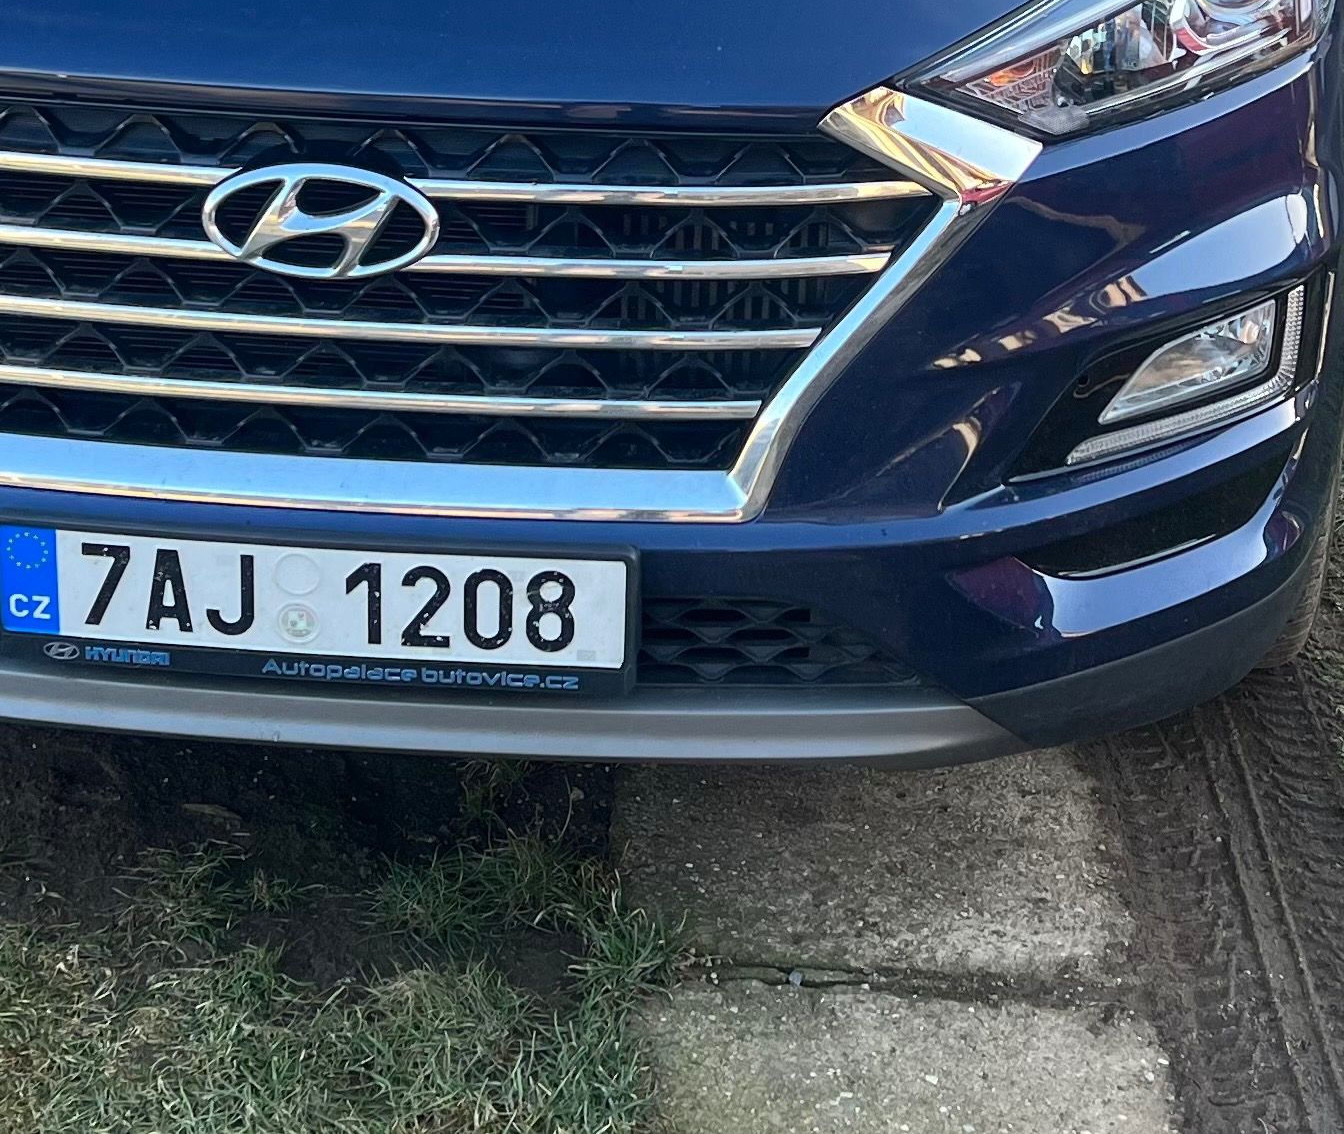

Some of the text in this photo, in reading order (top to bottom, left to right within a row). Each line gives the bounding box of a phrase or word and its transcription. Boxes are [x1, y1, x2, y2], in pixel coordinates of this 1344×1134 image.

[8, 592, 52, 620] CZ
[80, 542, 577, 652] 7AJ 1208
[85, 646, 171, 666] HYUNDAI
[261, 657, 580, 690] Autopalace butovice.cz
